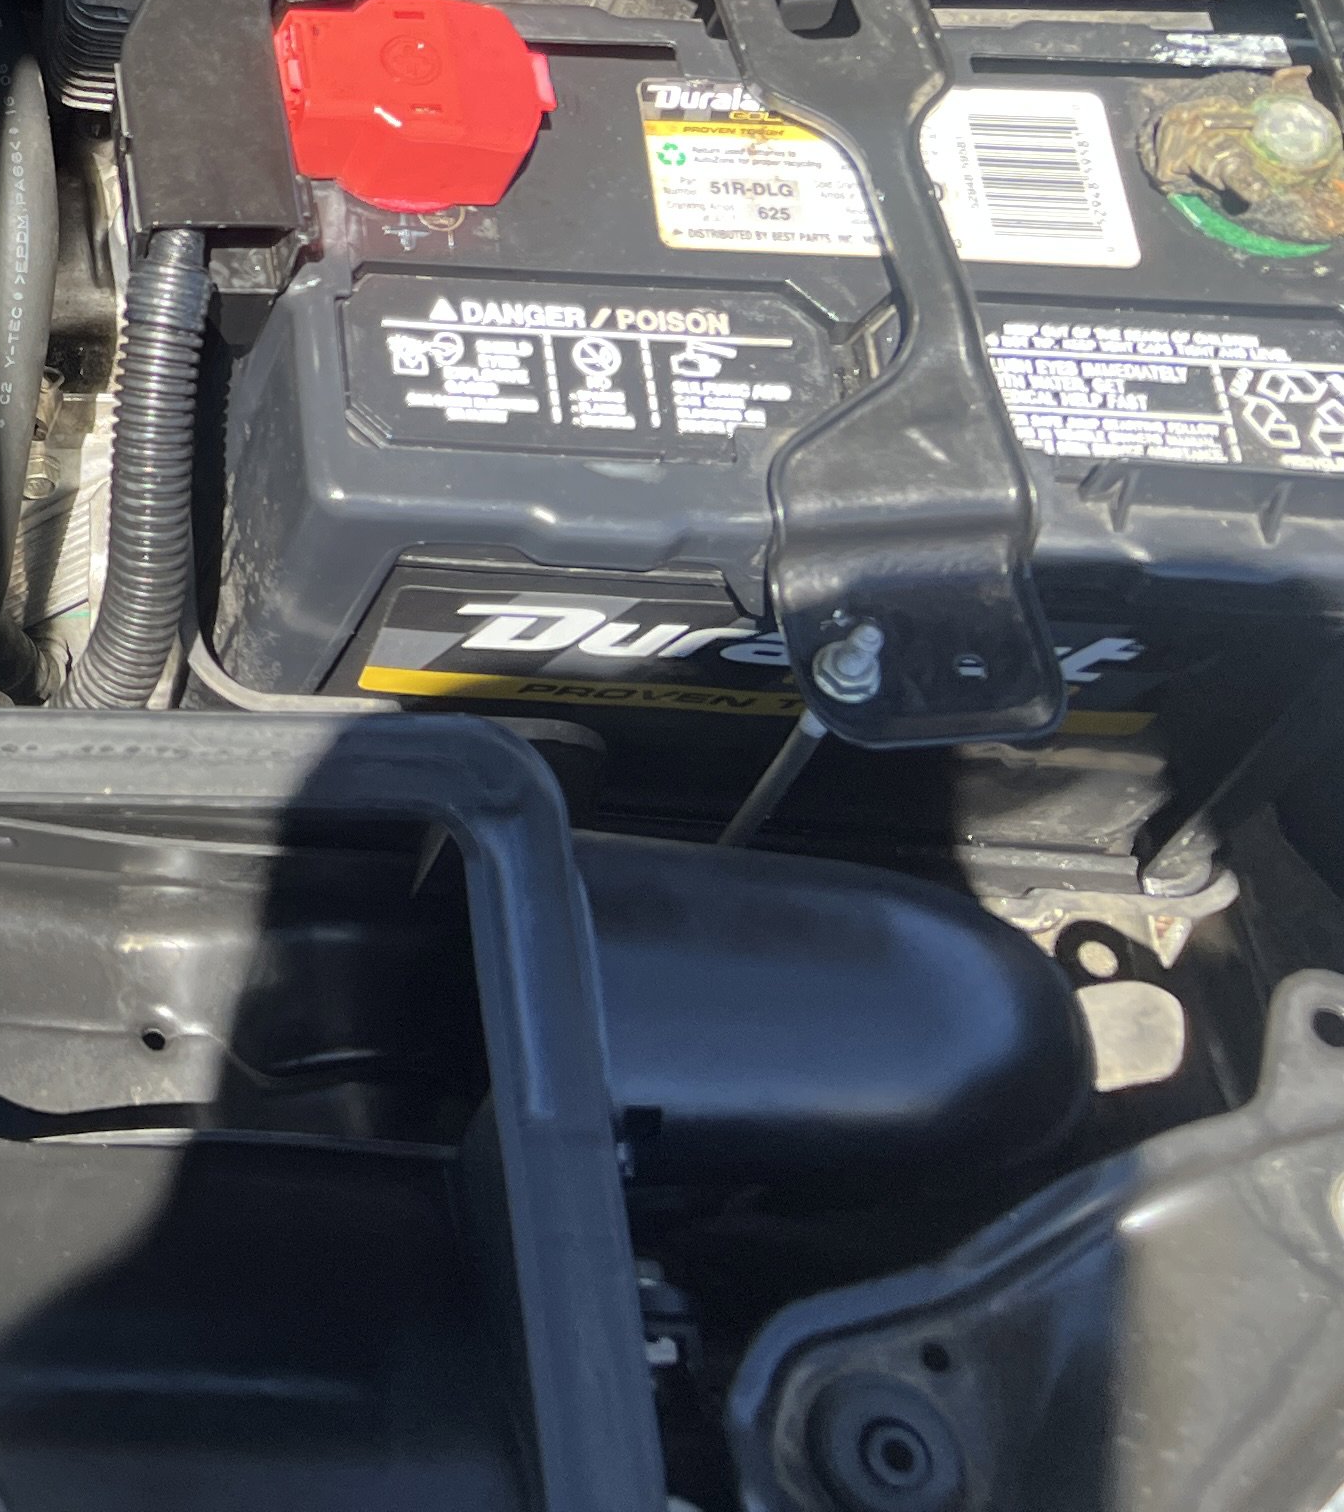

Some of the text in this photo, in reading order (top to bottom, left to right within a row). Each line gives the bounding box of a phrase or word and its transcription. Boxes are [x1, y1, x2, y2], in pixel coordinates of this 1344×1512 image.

[683, 126, 736, 135] PROVEN
[710, 181, 794, 198] 51R-DLG
[758, 206, 792, 221] 625
[688, 229, 753, 240] DISTRIBUTED
[756, 230, 768, 240] BY
[772, 231, 796, 241] BEST
[461, 300, 587, 328] DANGER
[615, 308, 731, 335] POISON
[4, 306, 23, 368] Y-TEC
[1035, 359, 1080, 378] EYES
[1081, 361, 1189, 383] IMMEDIATELY
[1091, 377, 1125, 394] GET
[1060, 391, 1103, 408] HELP
[517, 681, 755, 709] PROVEN
